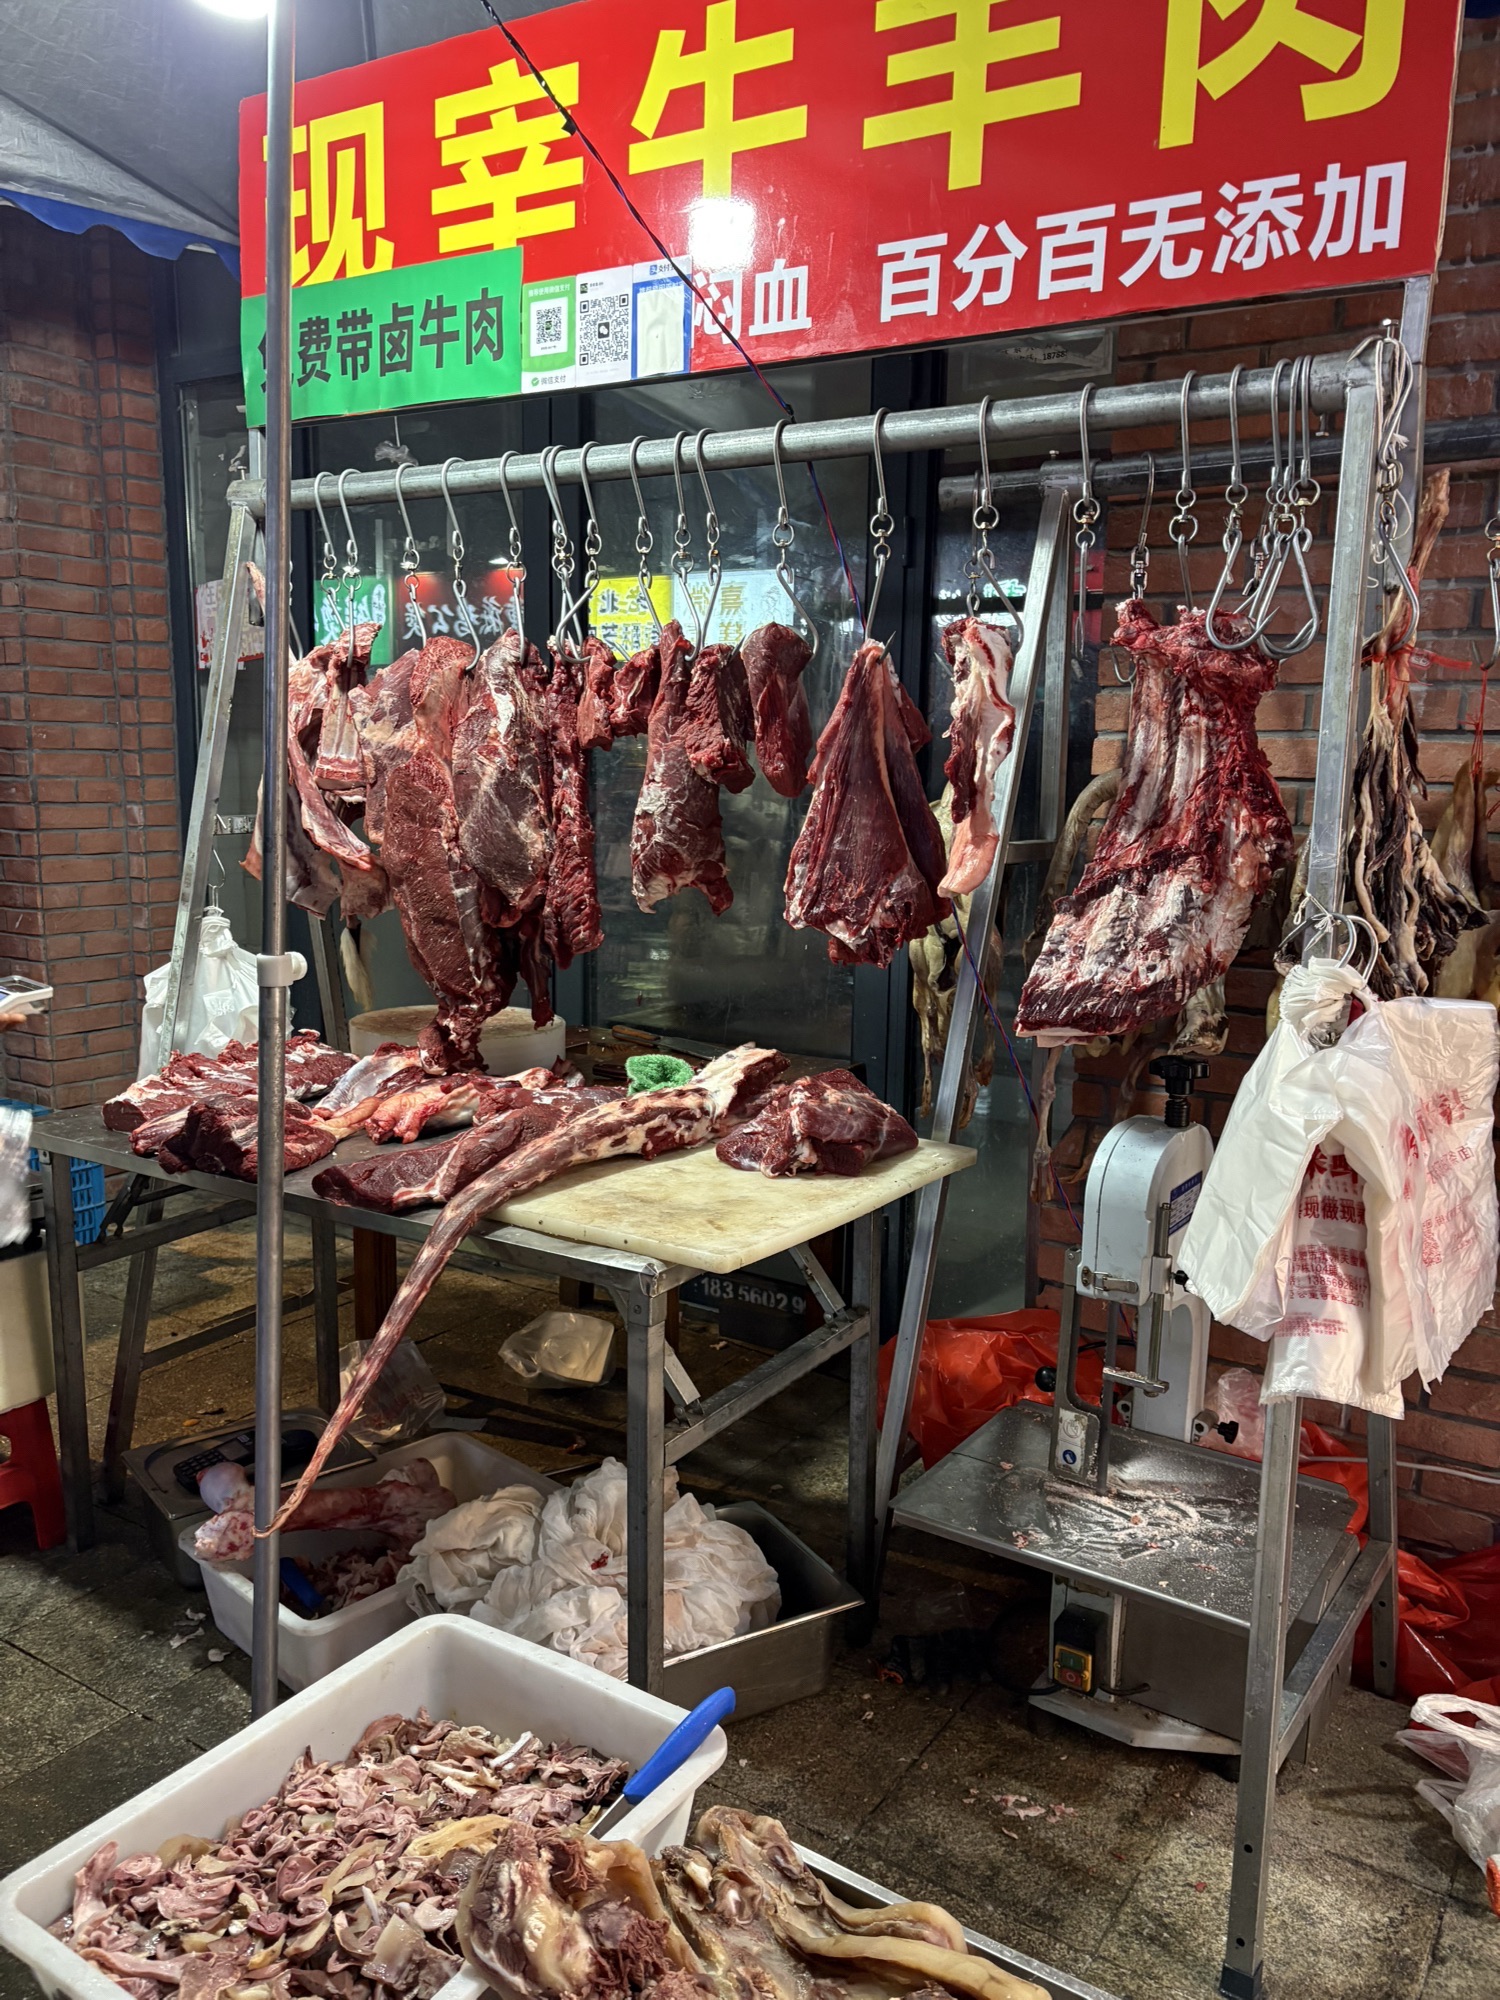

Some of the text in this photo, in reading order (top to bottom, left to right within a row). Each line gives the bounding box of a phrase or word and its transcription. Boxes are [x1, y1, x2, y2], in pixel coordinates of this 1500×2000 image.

[263, 0, 1405, 285] 现宰牛羊肉
[877, 161, 1407, 323] 百分百无添加
[257, 287, 504, 394] 费带卤牛肉
[541, 374, 567, 386] 微信支付
[1298, 1195, 1366, 1225] 现做现
